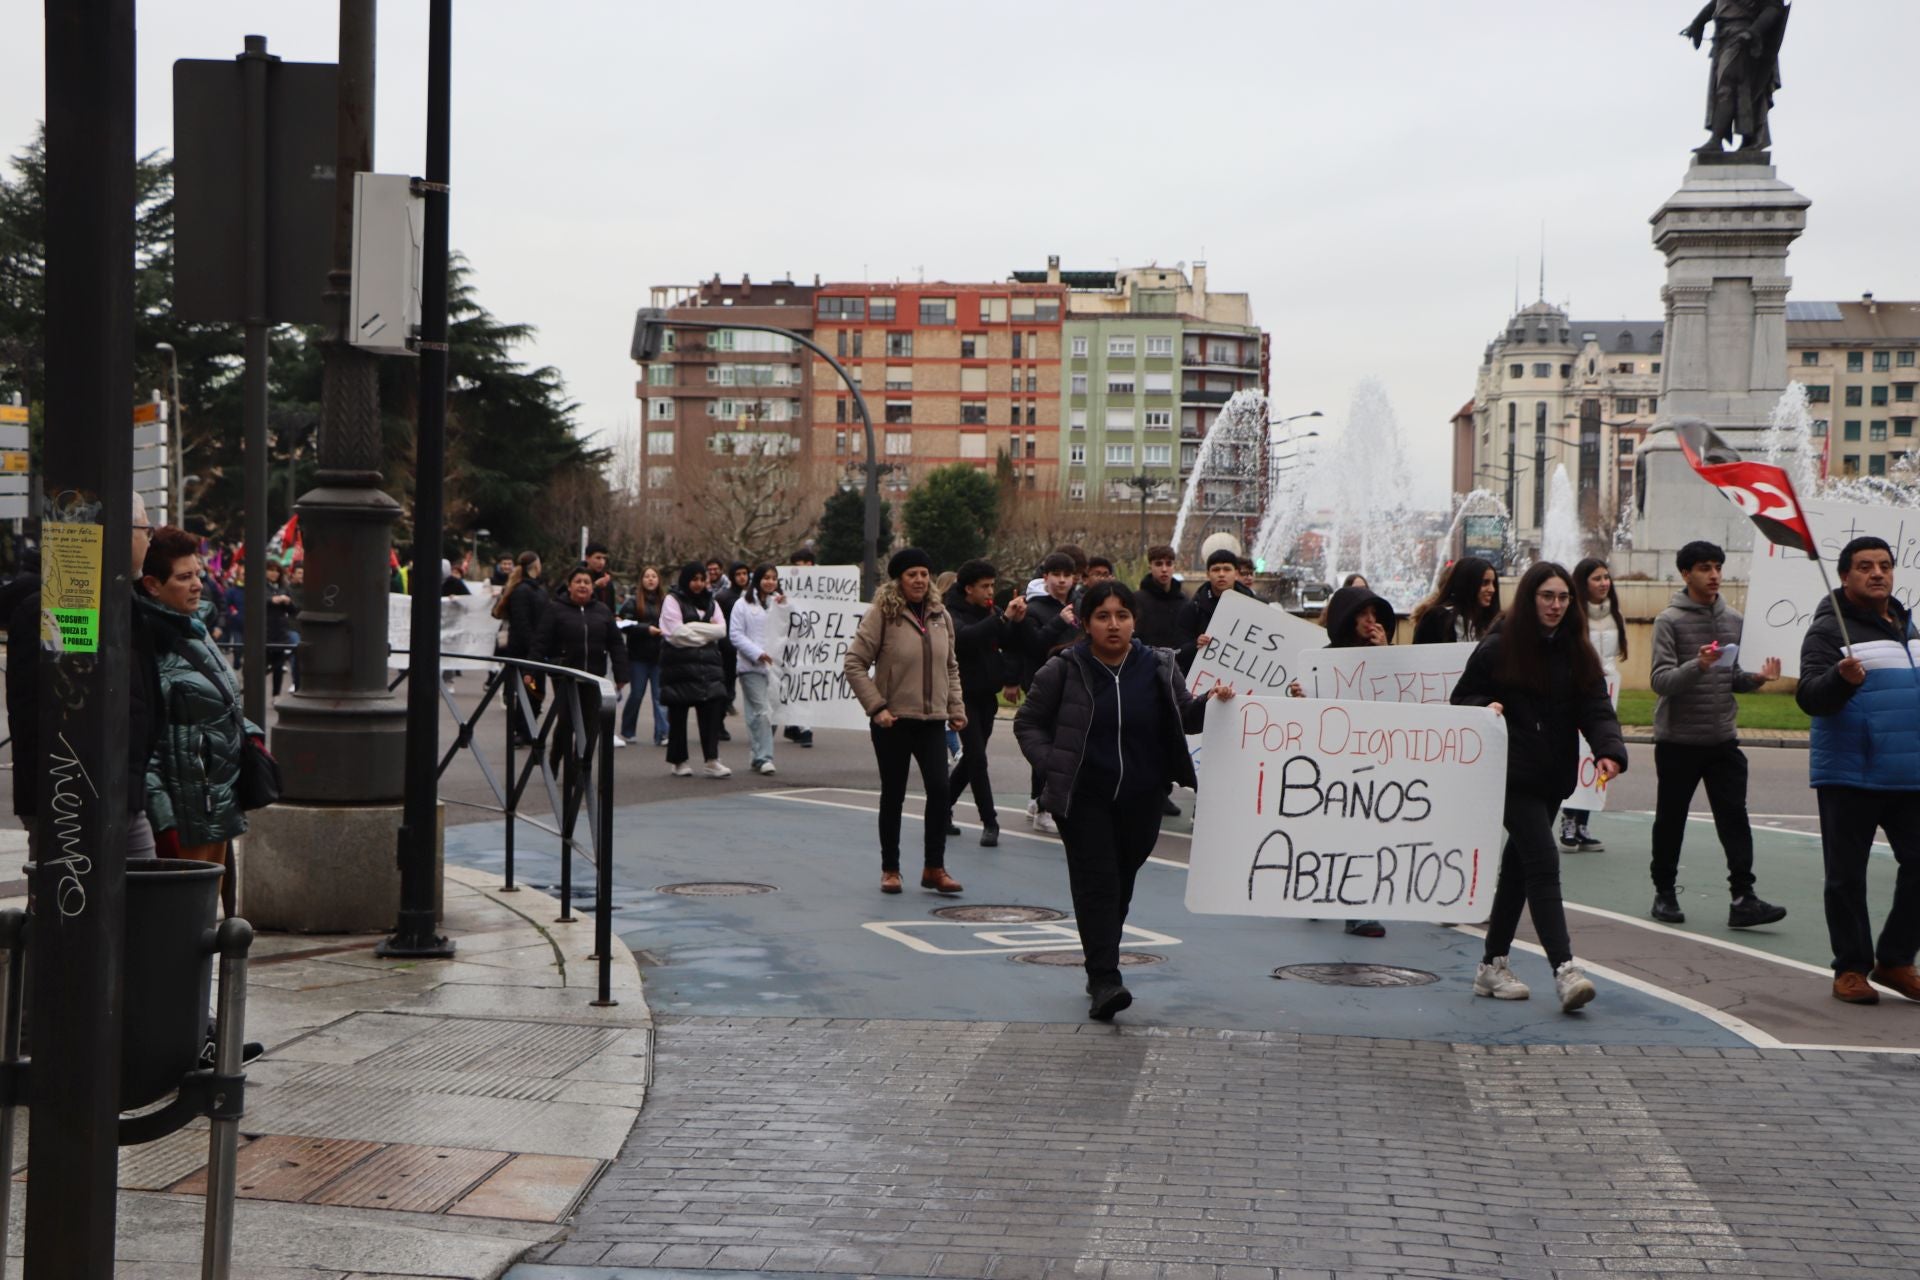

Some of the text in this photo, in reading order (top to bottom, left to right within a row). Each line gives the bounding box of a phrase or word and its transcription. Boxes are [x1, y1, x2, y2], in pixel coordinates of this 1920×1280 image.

[797, 575, 813, 592] LA
[81, 628, 88, 636] ES
[824, 612, 845, 639] EL
[1229, 618, 1286, 652] IES
[1240, 702, 1303, 752] POR
